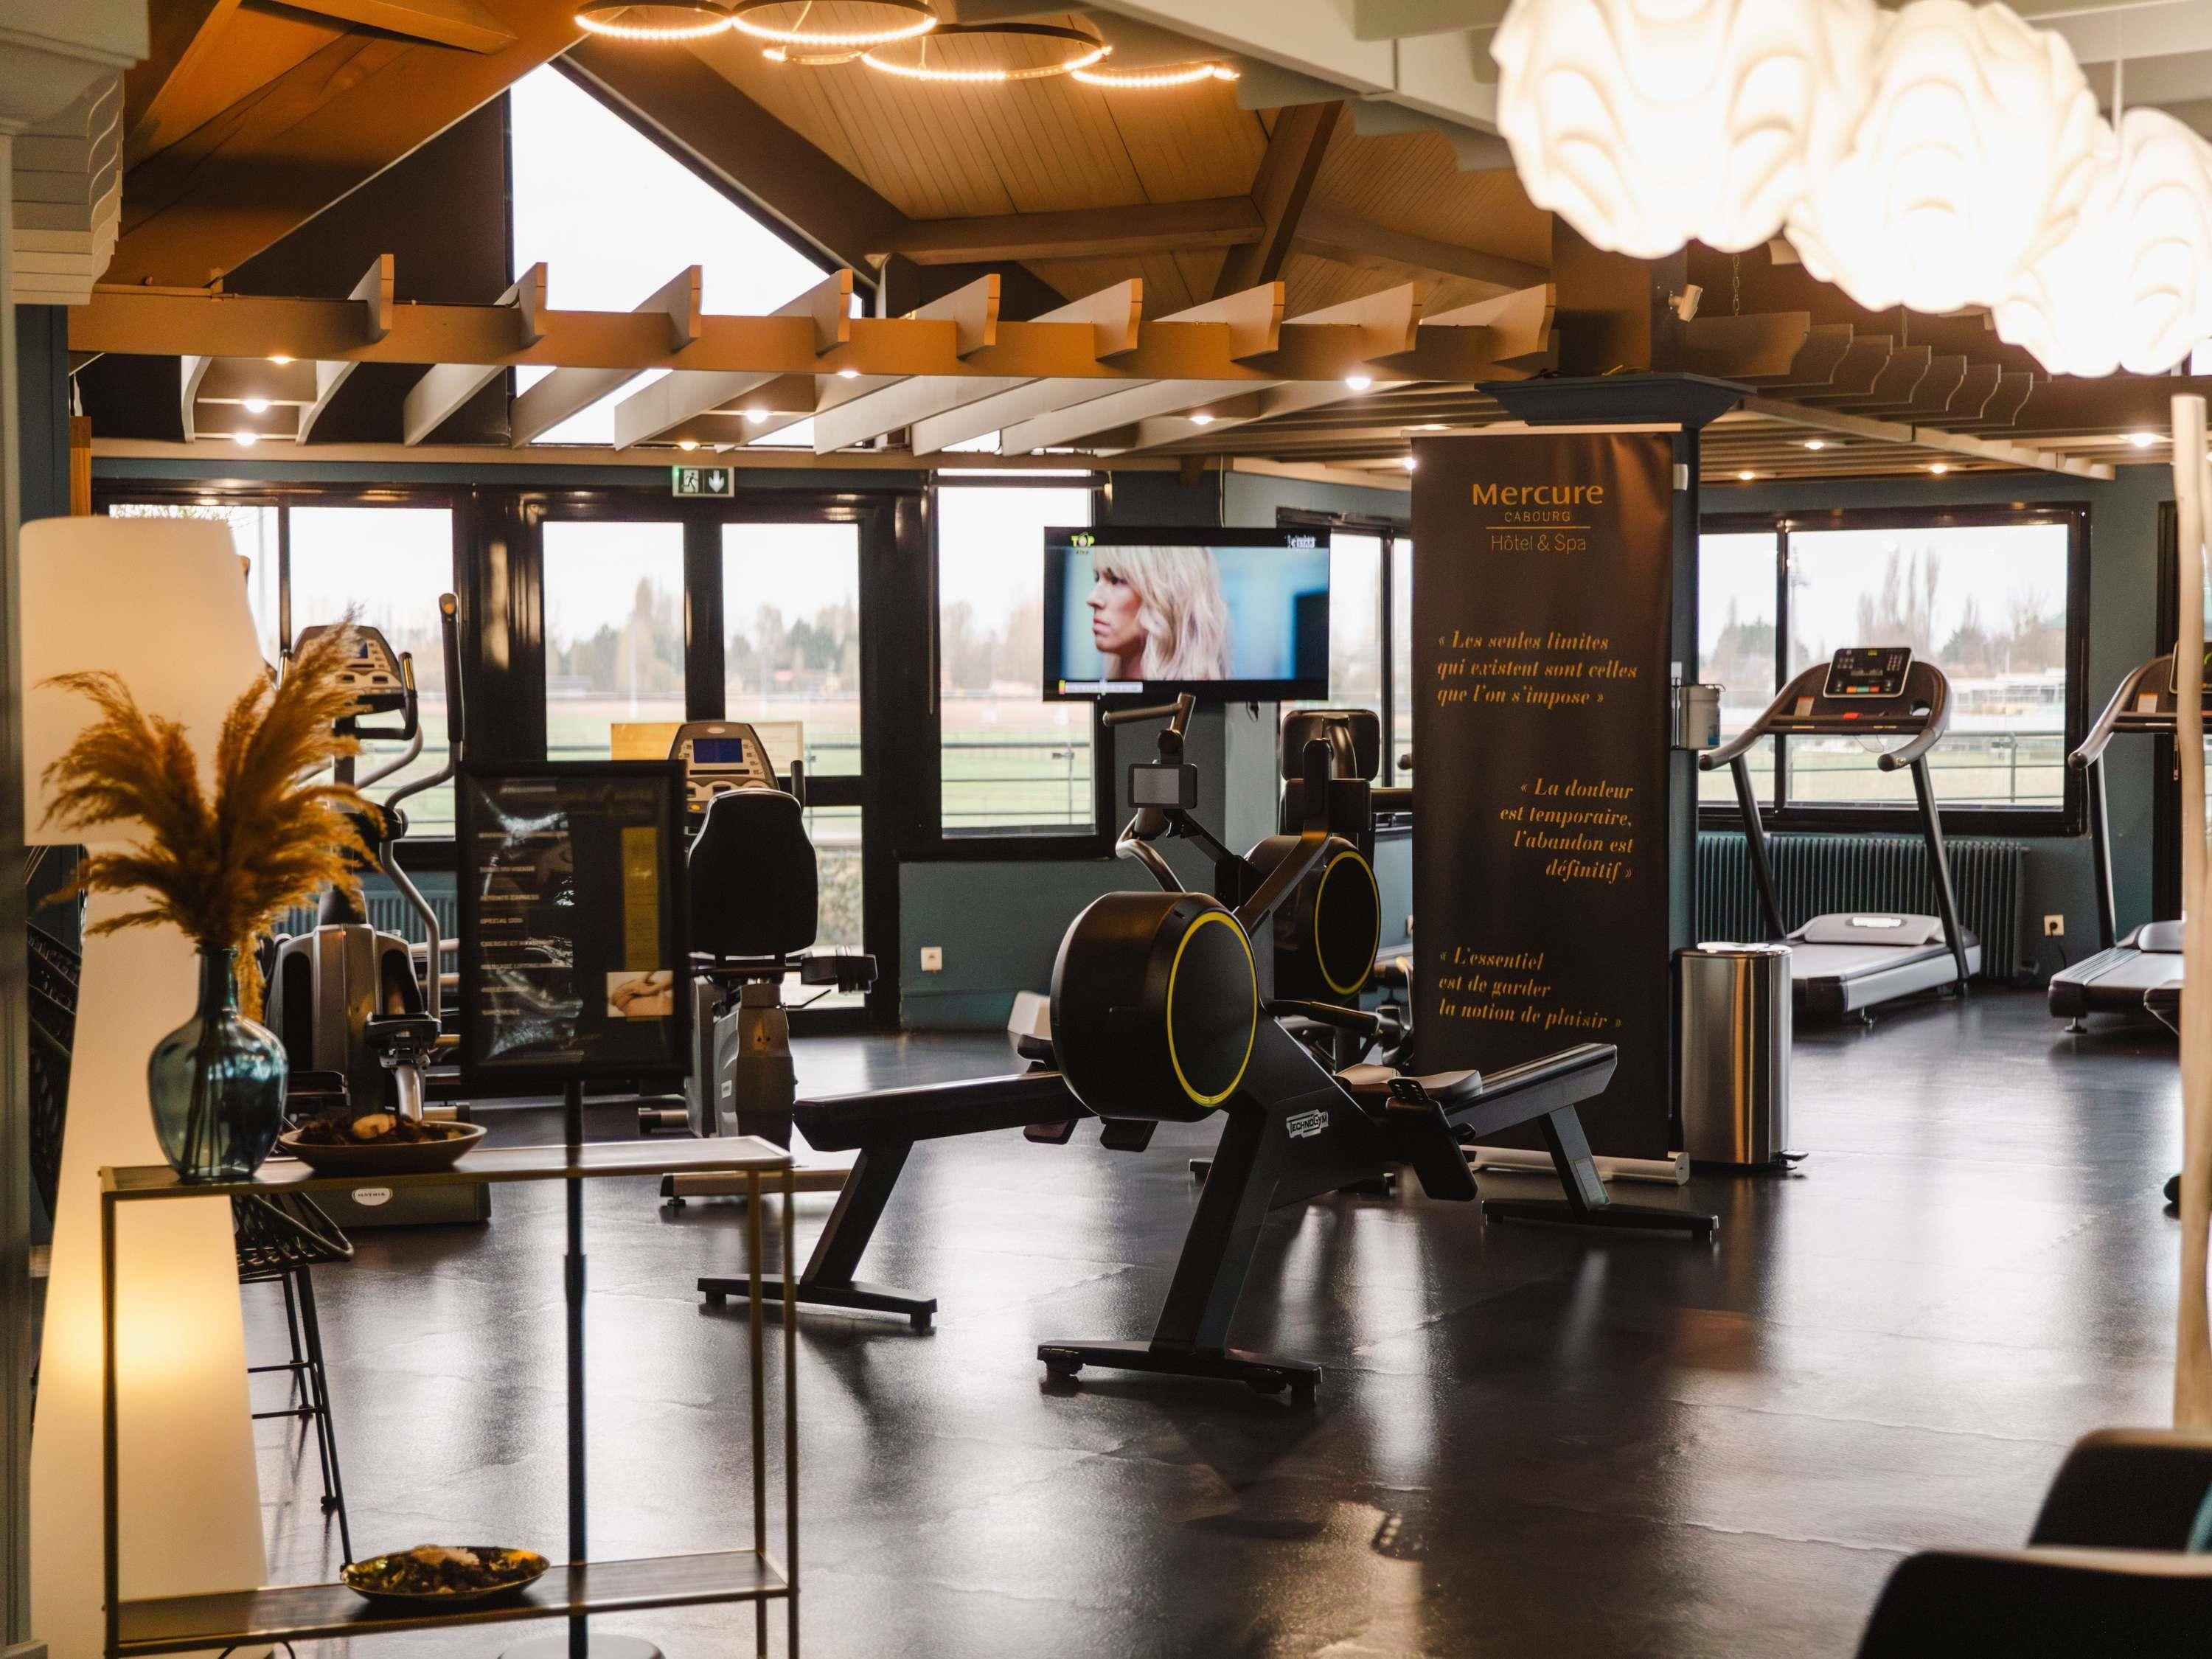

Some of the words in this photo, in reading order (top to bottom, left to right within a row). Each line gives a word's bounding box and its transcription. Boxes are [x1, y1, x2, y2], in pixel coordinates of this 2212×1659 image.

[1472, 484, 1604, 505] Mercure
[1505, 511, 1571, 524] CABOURG
[1491, 535, 1533, 552] Hôtel
[1538, 535, 1550, 552] &
[1554, 534, 1587, 554] Spa
[1452, 630, 1483, 649] Les
[1489, 631, 1541, 649] seules
[1548, 632, 1610, 650] limites
[1437, 658, 1464, 680] qui
[1471, 659, 1539, 677] existent
[1545, 661, 1583, 677] sont
[1588, 661, 1638, 678] celles
[1437, 689, 1467, 706] que
[1473, 684, 1506, 703] l'on
[1512, 685, 1590, 709] s'impose
[1534, 779, 1559, 796] La
[1565, 779, 1634, 799] douleur
[1500, 806, 1523, 821] est
[1529, 807, 1632, 829] temporaire,
[1514, 830, 1604, 852] l'abandon
[1610, 838, 1633, 853] est
[1545, 859, 1622, 884] définitif
[1454, 946, 1544, 970] L'essentiel
[1439, 975, 1462, 991] est
[1468, 975, 1487, 992] de
[1492, 978, 1551, 997] garder
[1439, 998, 1457, 1016] la
[1461, 1004, 1515, 1021] notion
[1520, 1006, 1540, 1023] de
[1545, 1007, 1607, 1030] plaisir
[1287, 1112, 1327, 1135] TECHNOGYM
